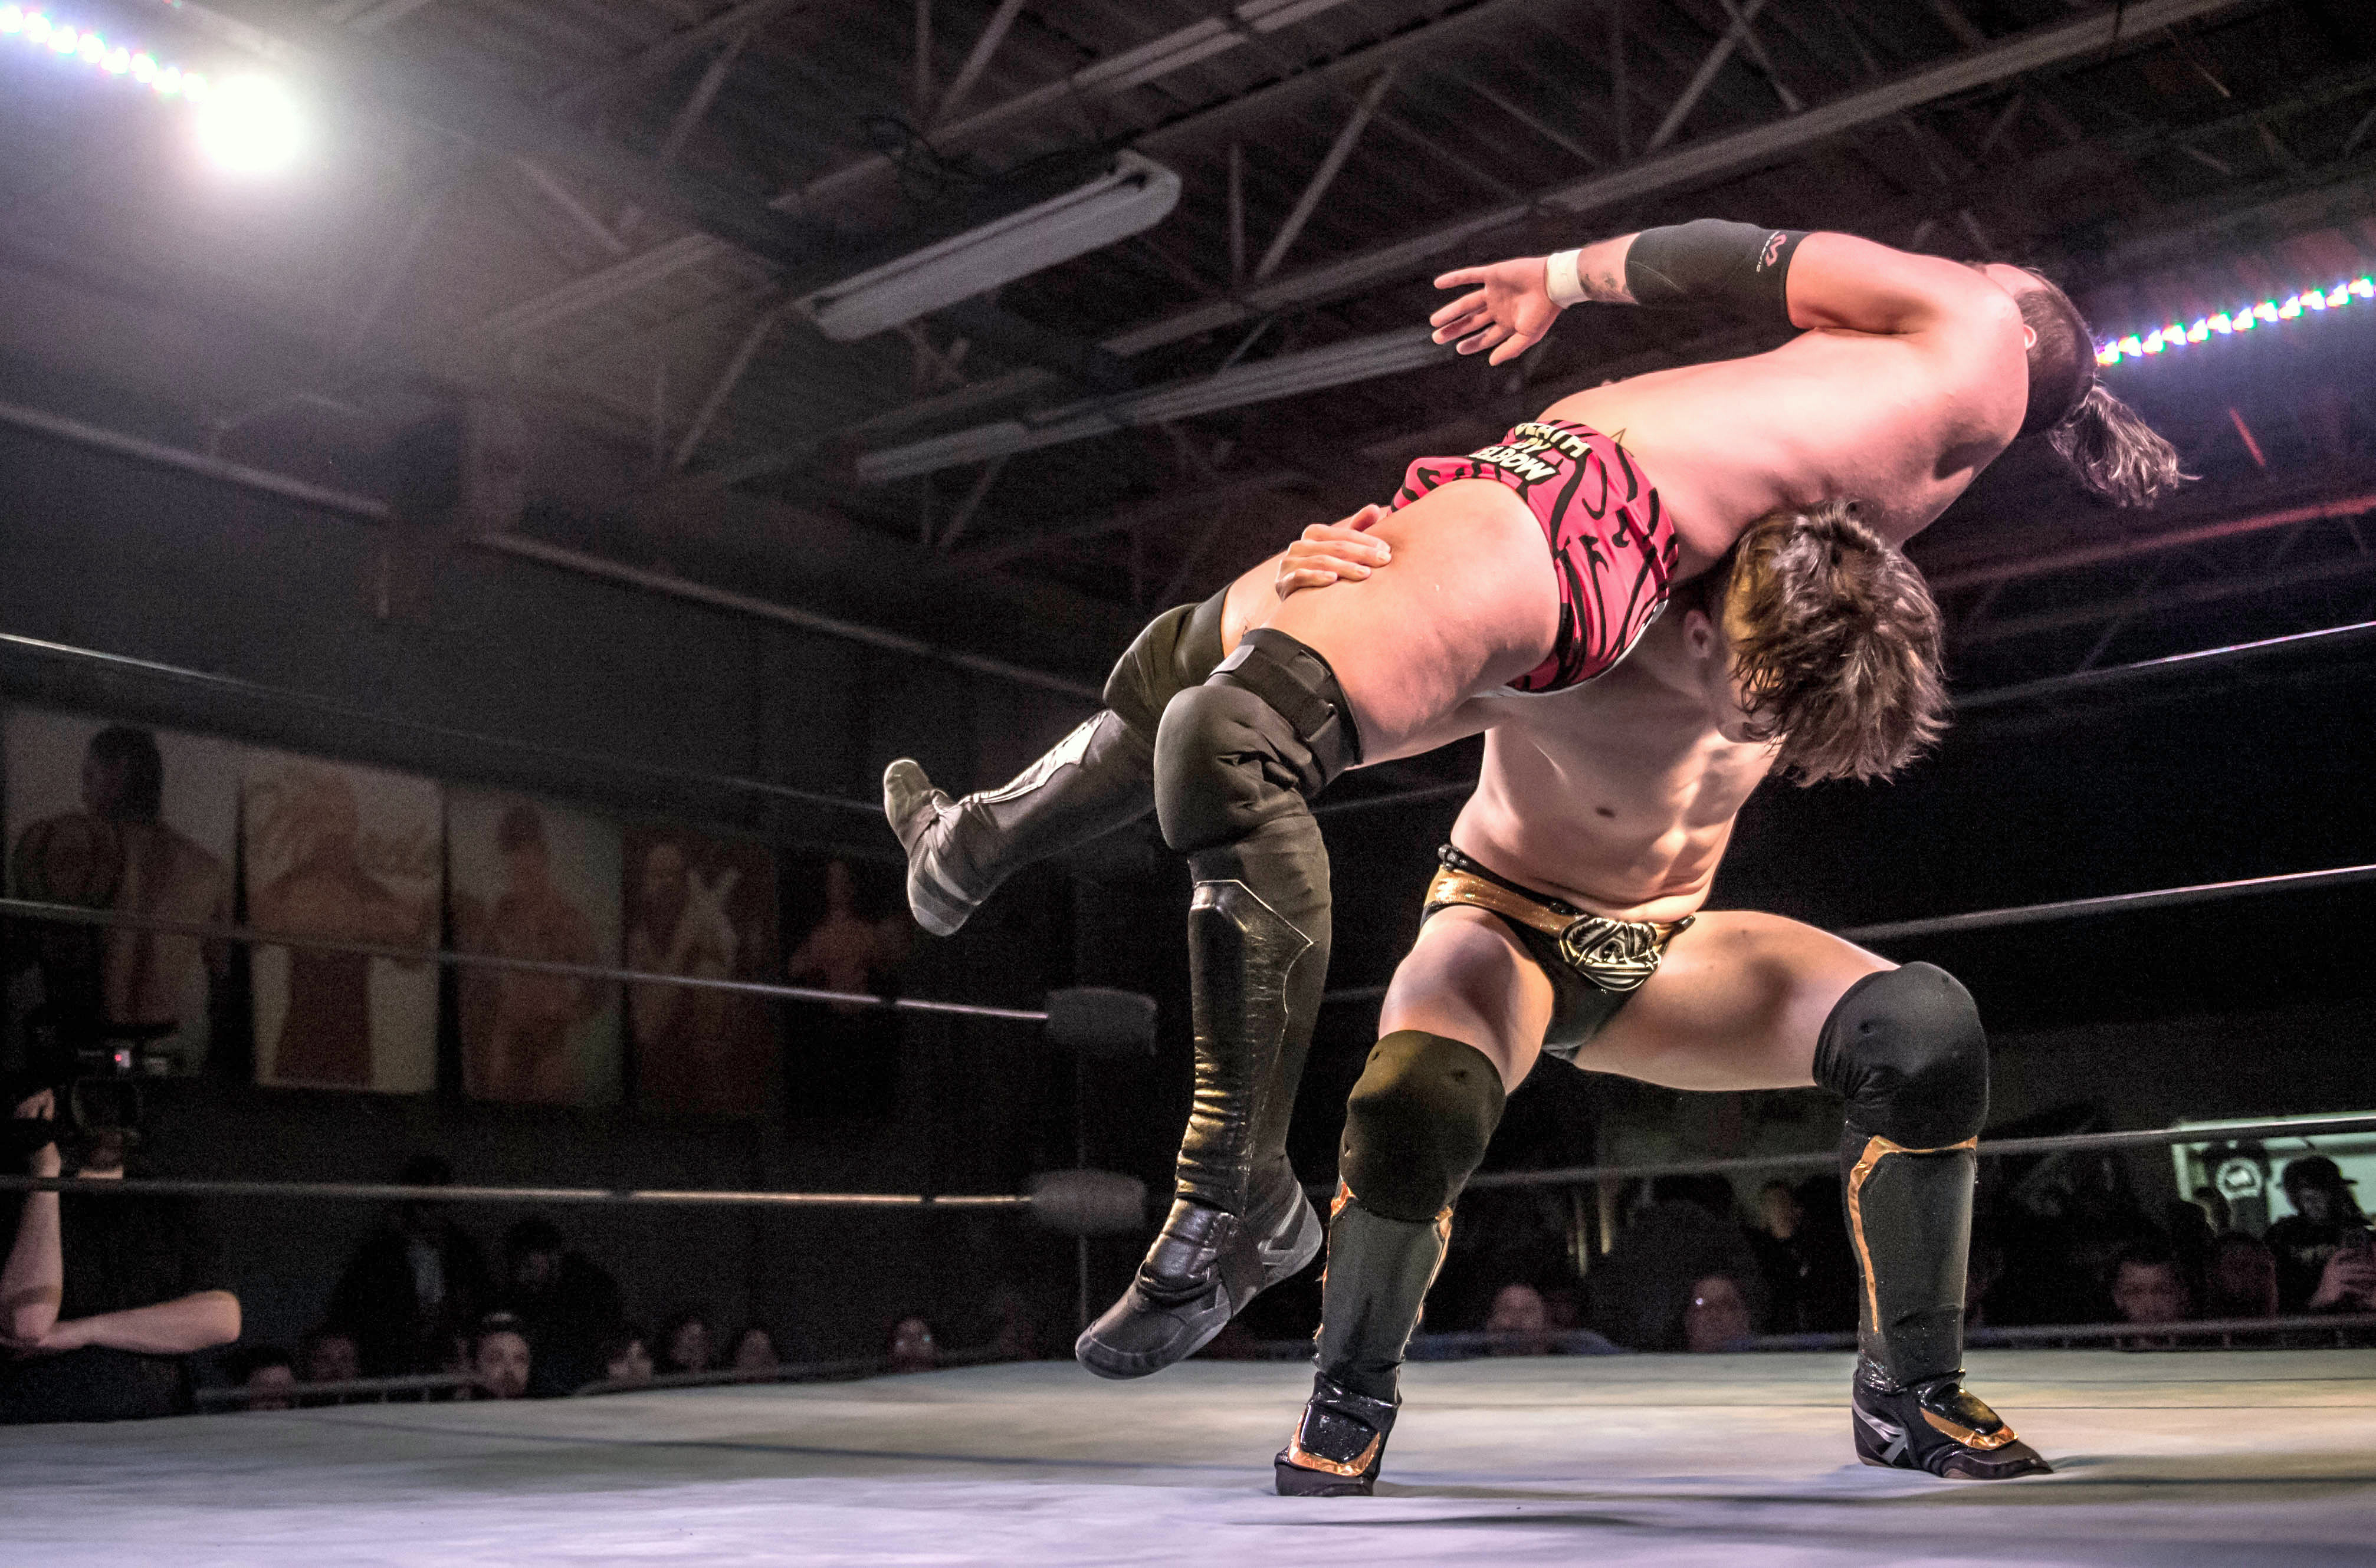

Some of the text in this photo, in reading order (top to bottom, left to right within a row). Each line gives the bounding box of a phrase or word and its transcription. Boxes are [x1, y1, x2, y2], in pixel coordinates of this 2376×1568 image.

[1510, 438, 1551, 453] BY
[1515, 422, 1592, 458] DEATH
[1469, 446, 1555, 481] ELBOW
